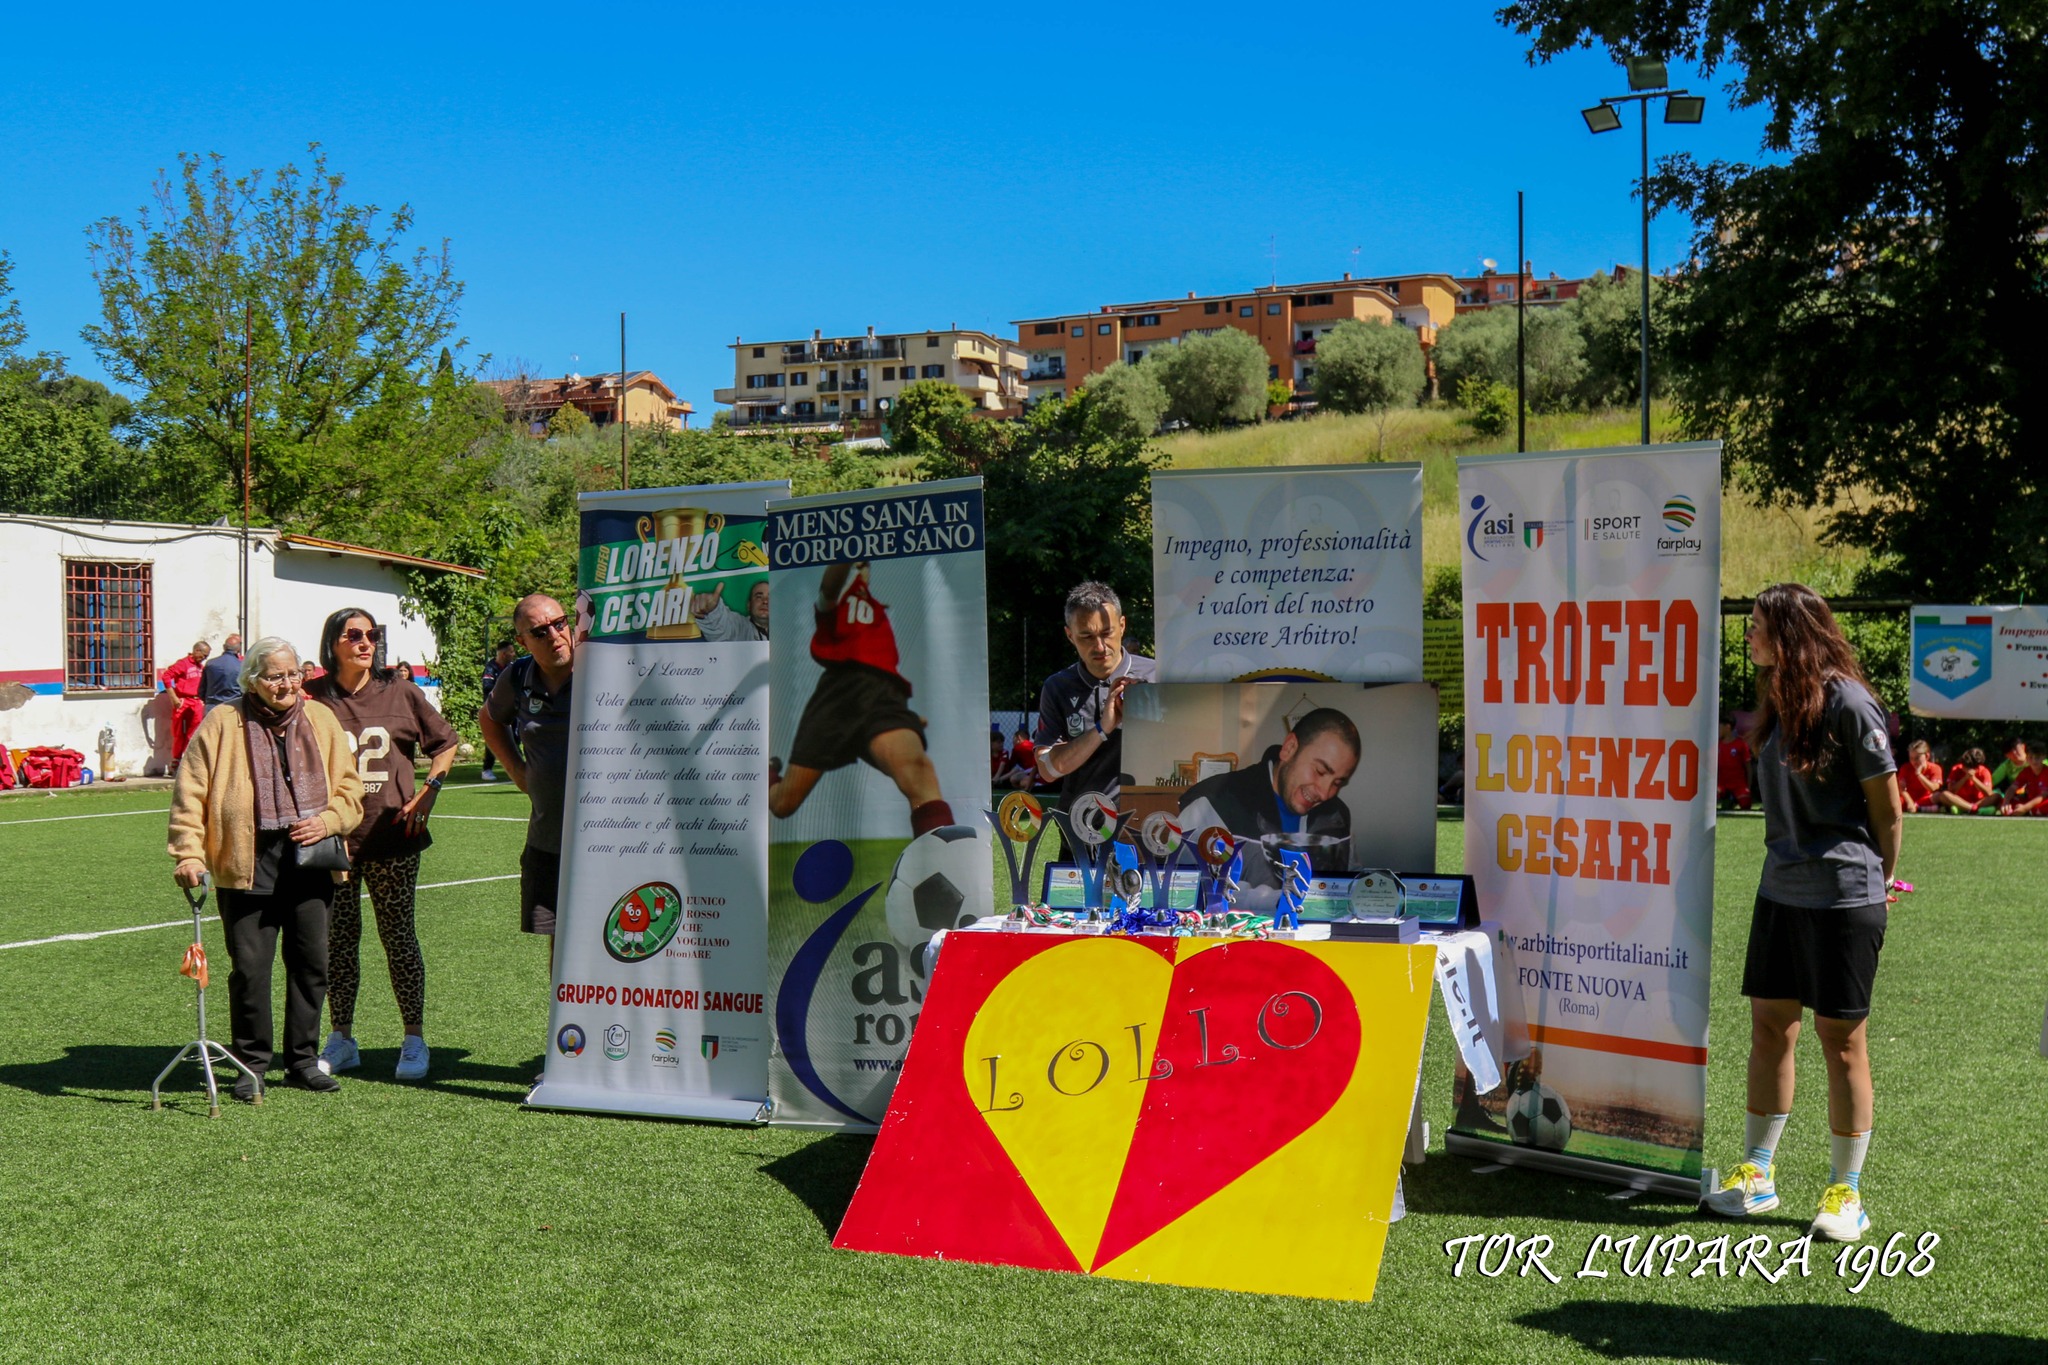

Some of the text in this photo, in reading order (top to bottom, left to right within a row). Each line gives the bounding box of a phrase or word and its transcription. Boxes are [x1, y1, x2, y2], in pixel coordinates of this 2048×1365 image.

[775, 498, 969, 541] MENS SANA IN
[1484, 512, 1515, 535] asi
[1593, 516, 1641, 530] SPORT
[774, 523, 975, 566] CORPORE SANO
[1163, 528, 1412, 561] Impegno, professionalità
[1593, 531, 1641, 541] E SALUTE
[1657, 536, 1702, 552] fairplay
[594, 545, 611, 584] TROFEO
[606, 532, 720, 584] LORENZO
[1214, 566, 1355, 590] e competenza:
[600, 586, 693, 634] CESARI
[846, 595, 875, 625] 10
[1198, 591, 1374, 615] i valori del nostro
[1213, 623, 1358, 648] essere Arbitro!
[1476, 599, 1699, 707] TROFEO
[595, 691, 746, 710] Voler essere arbitro significa
[576, 719, 611, 732] credere
[614, 719, 644, 732] nella
[697, 719, 723, 732] nella
[579, 745, 627, 756] conoscere
[630, 743, 641, 756] la
[643, 745, 690, 759] passione
[694, 746, 702, 756] e
[575, 768, 760, 784] vivere ogni istante della vita come
[1475, 733, 1700, 802] LORENZO
[579, 791, 750, 806] dono avendo il cuore colmo di
[580, 816, 749, 835] gratitudine e gli occhi limpidi
[587, 841, 739, 857] come quelli di un bambino.
[1497, 814, 1672, 885] CESARI
[686, 910, 720, 919] ROSSO
[682, 923, 703, 933] CHE
[676, 936, 730, 948] VOGLIAMO
[665, 948, 712, 960] D(on)ARE
[1519, 966, 1647, 1001] FONTE NUOVA
[556, 983, 763, 1014] GRUPPO DONATORI SANGUE
[1559, 997, 1600, 1020] (Roma)
[651, 1053, 680, 1066] fairplay
[978, 990, 1324, 1116] LOLLO
